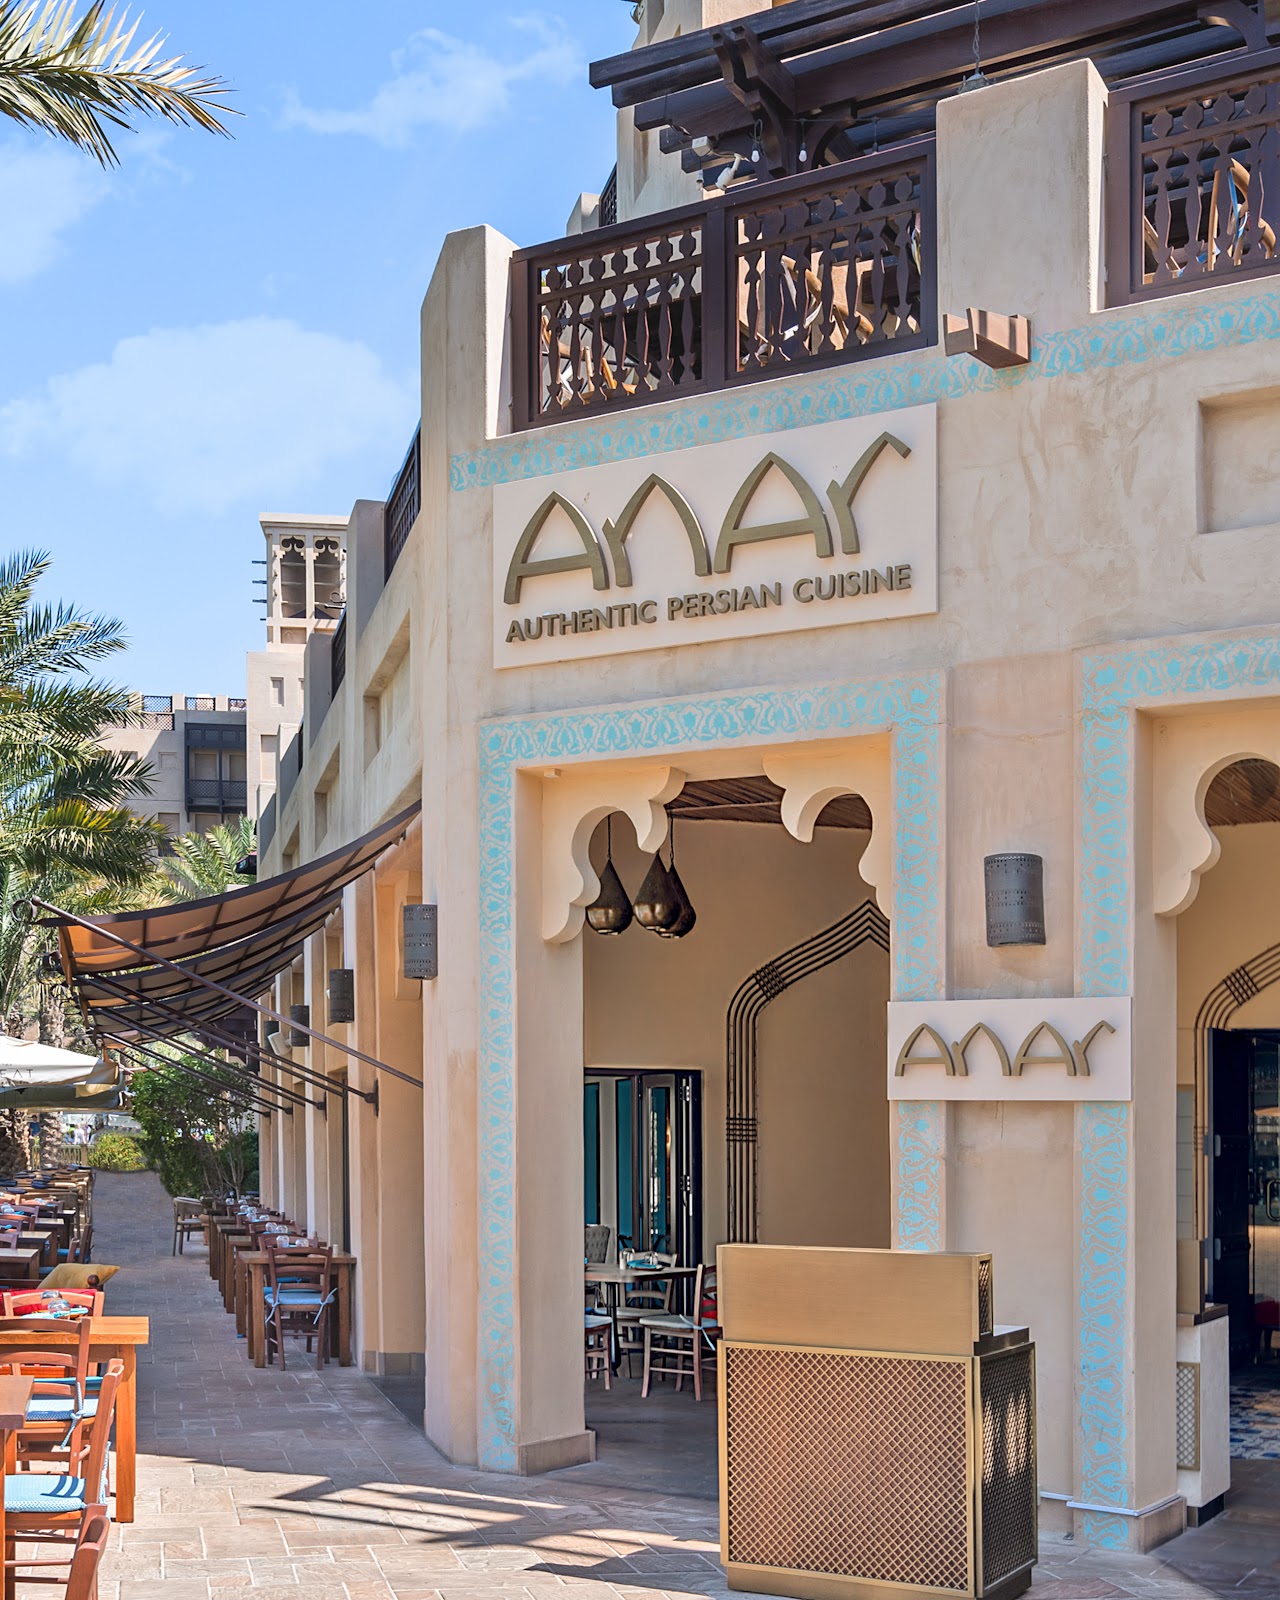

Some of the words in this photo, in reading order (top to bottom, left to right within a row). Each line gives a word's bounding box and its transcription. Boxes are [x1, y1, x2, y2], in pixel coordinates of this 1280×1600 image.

[505, 600, 658, 643] AUTHENTIC
[667, 581, 782, 621] PERSIAN
[792, 563, 912, 604] CUISINE
